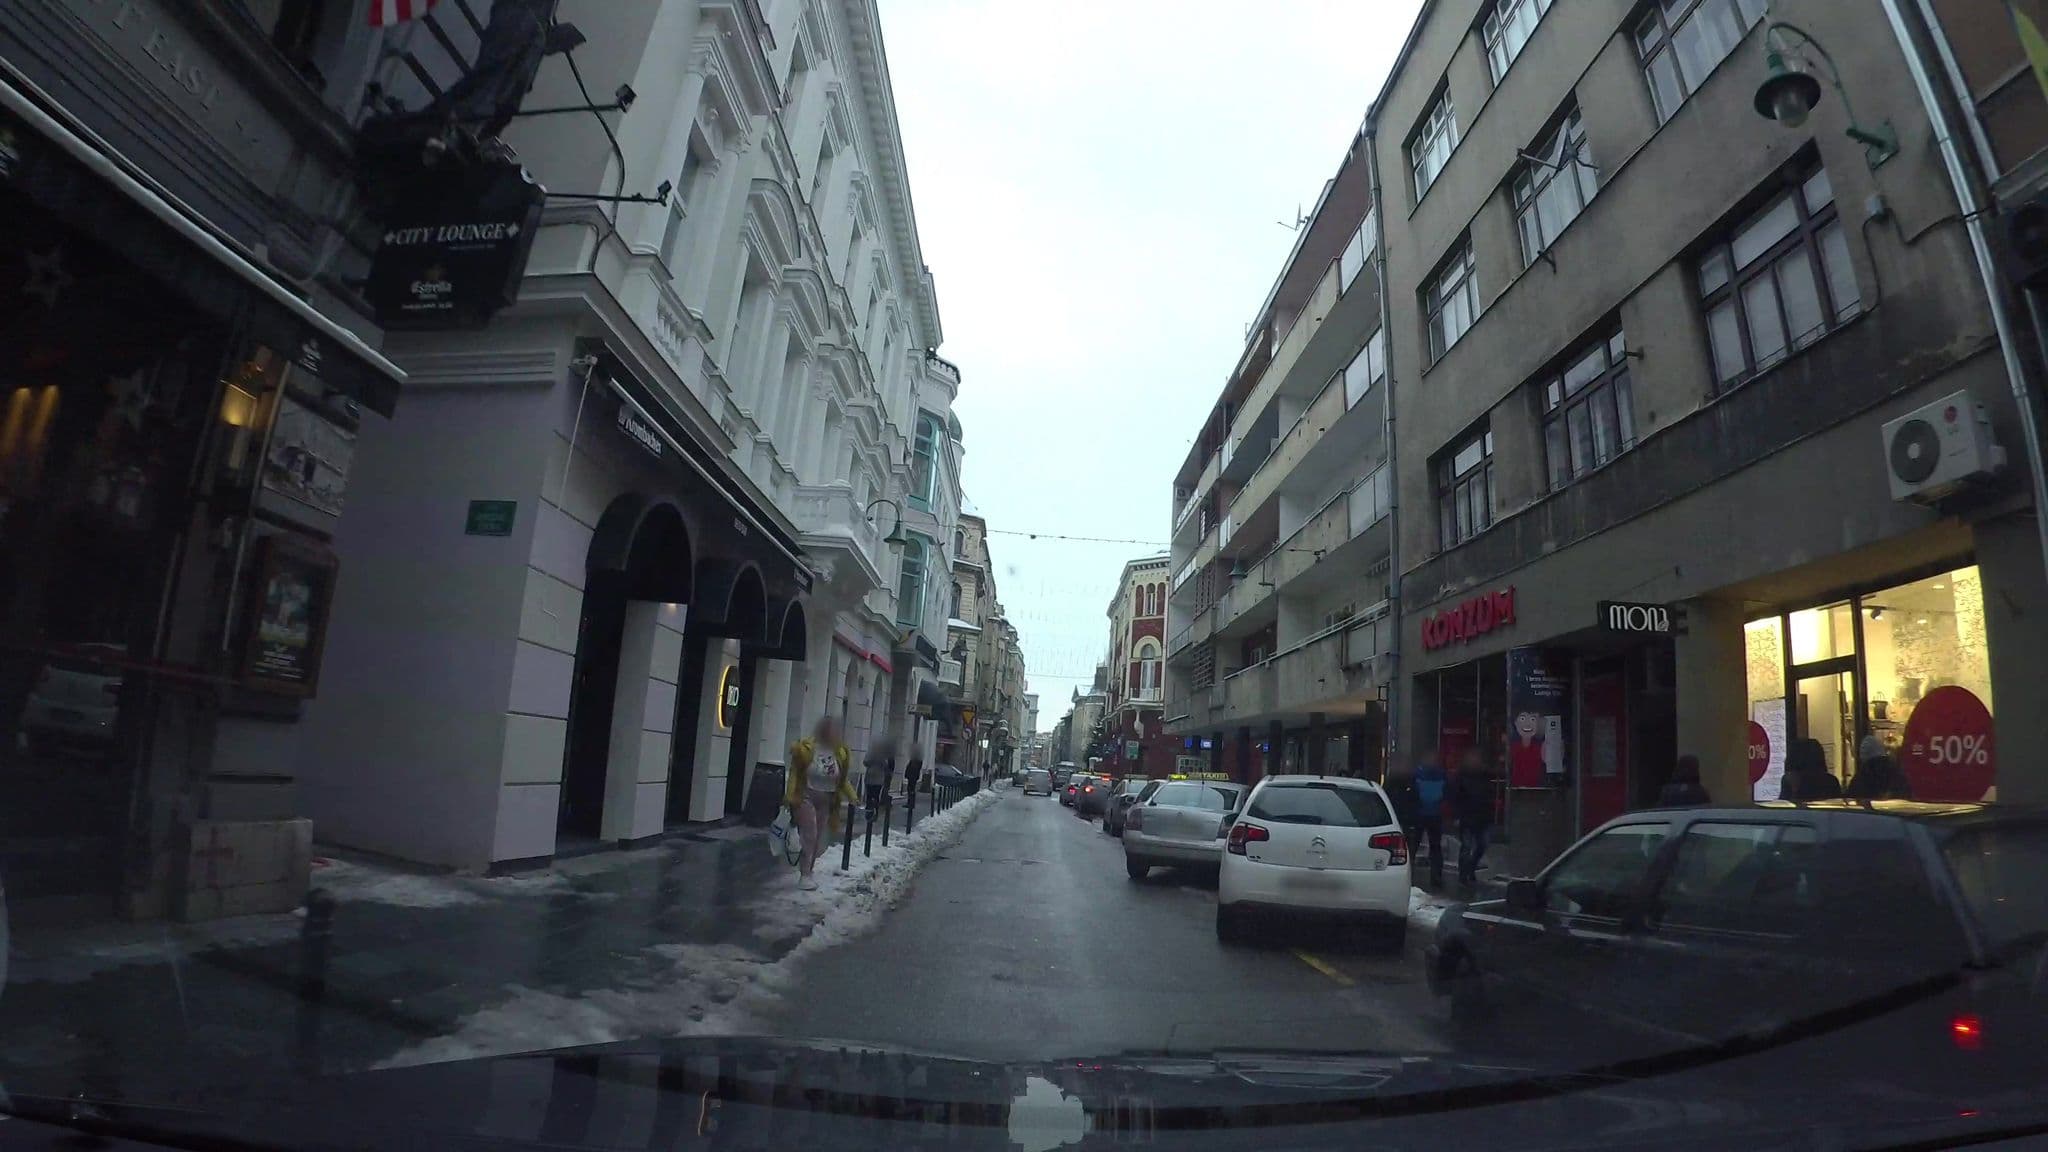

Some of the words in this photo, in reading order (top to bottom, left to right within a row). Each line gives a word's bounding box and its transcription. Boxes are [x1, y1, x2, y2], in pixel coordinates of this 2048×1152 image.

[396, 226, 434, 246] CITY
[437, 222, 506, 243] LOUNGE
[1422, 584, 1517, 649] KONZUM
[1928, 734, 1989, 765] 50%
